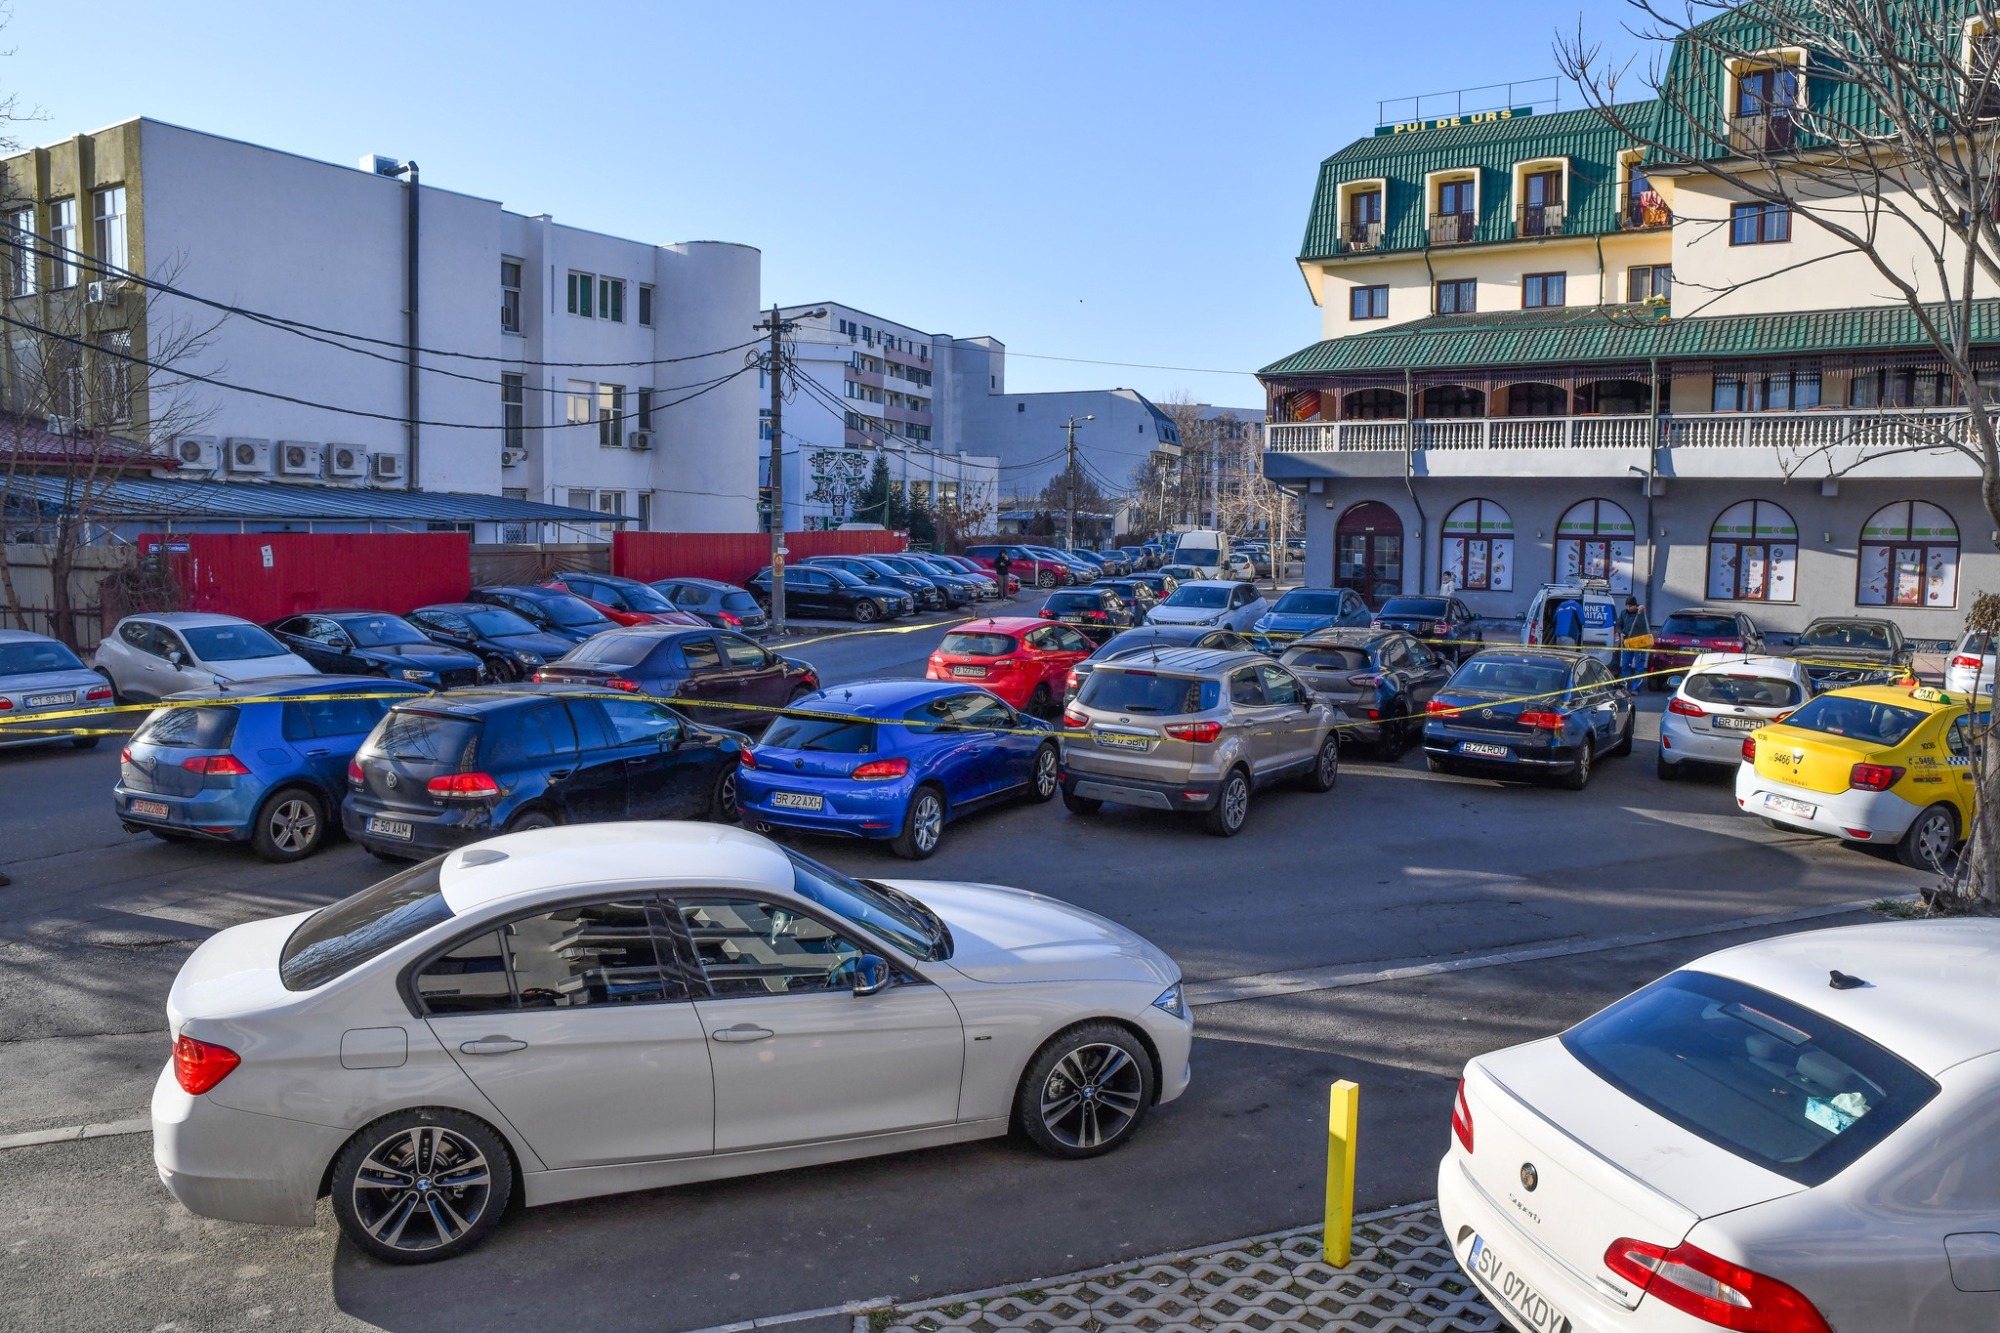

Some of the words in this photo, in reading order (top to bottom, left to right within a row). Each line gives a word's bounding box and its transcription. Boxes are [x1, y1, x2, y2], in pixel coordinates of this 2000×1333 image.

[1394, 121, 1426, 134] PUI
[1436, 117, 1461, 129] DE
[1471, 110, 1512, 124] URS
[1919, 688, 1935, 699] TAXI
[31, 697, 43, 706] CT
[46, 696, 56, 704] 92
[1718, 718, 1731, 727] BR
[1773, 752, 1791, 765] 9466
[776, 793, 788, 804] BR
[371, 818, 379, 830] IF
[380, 820, 390, 833] 50
[392, 822, 408, 836] AAM
[1478, 1247, 1503, 1282] SV
